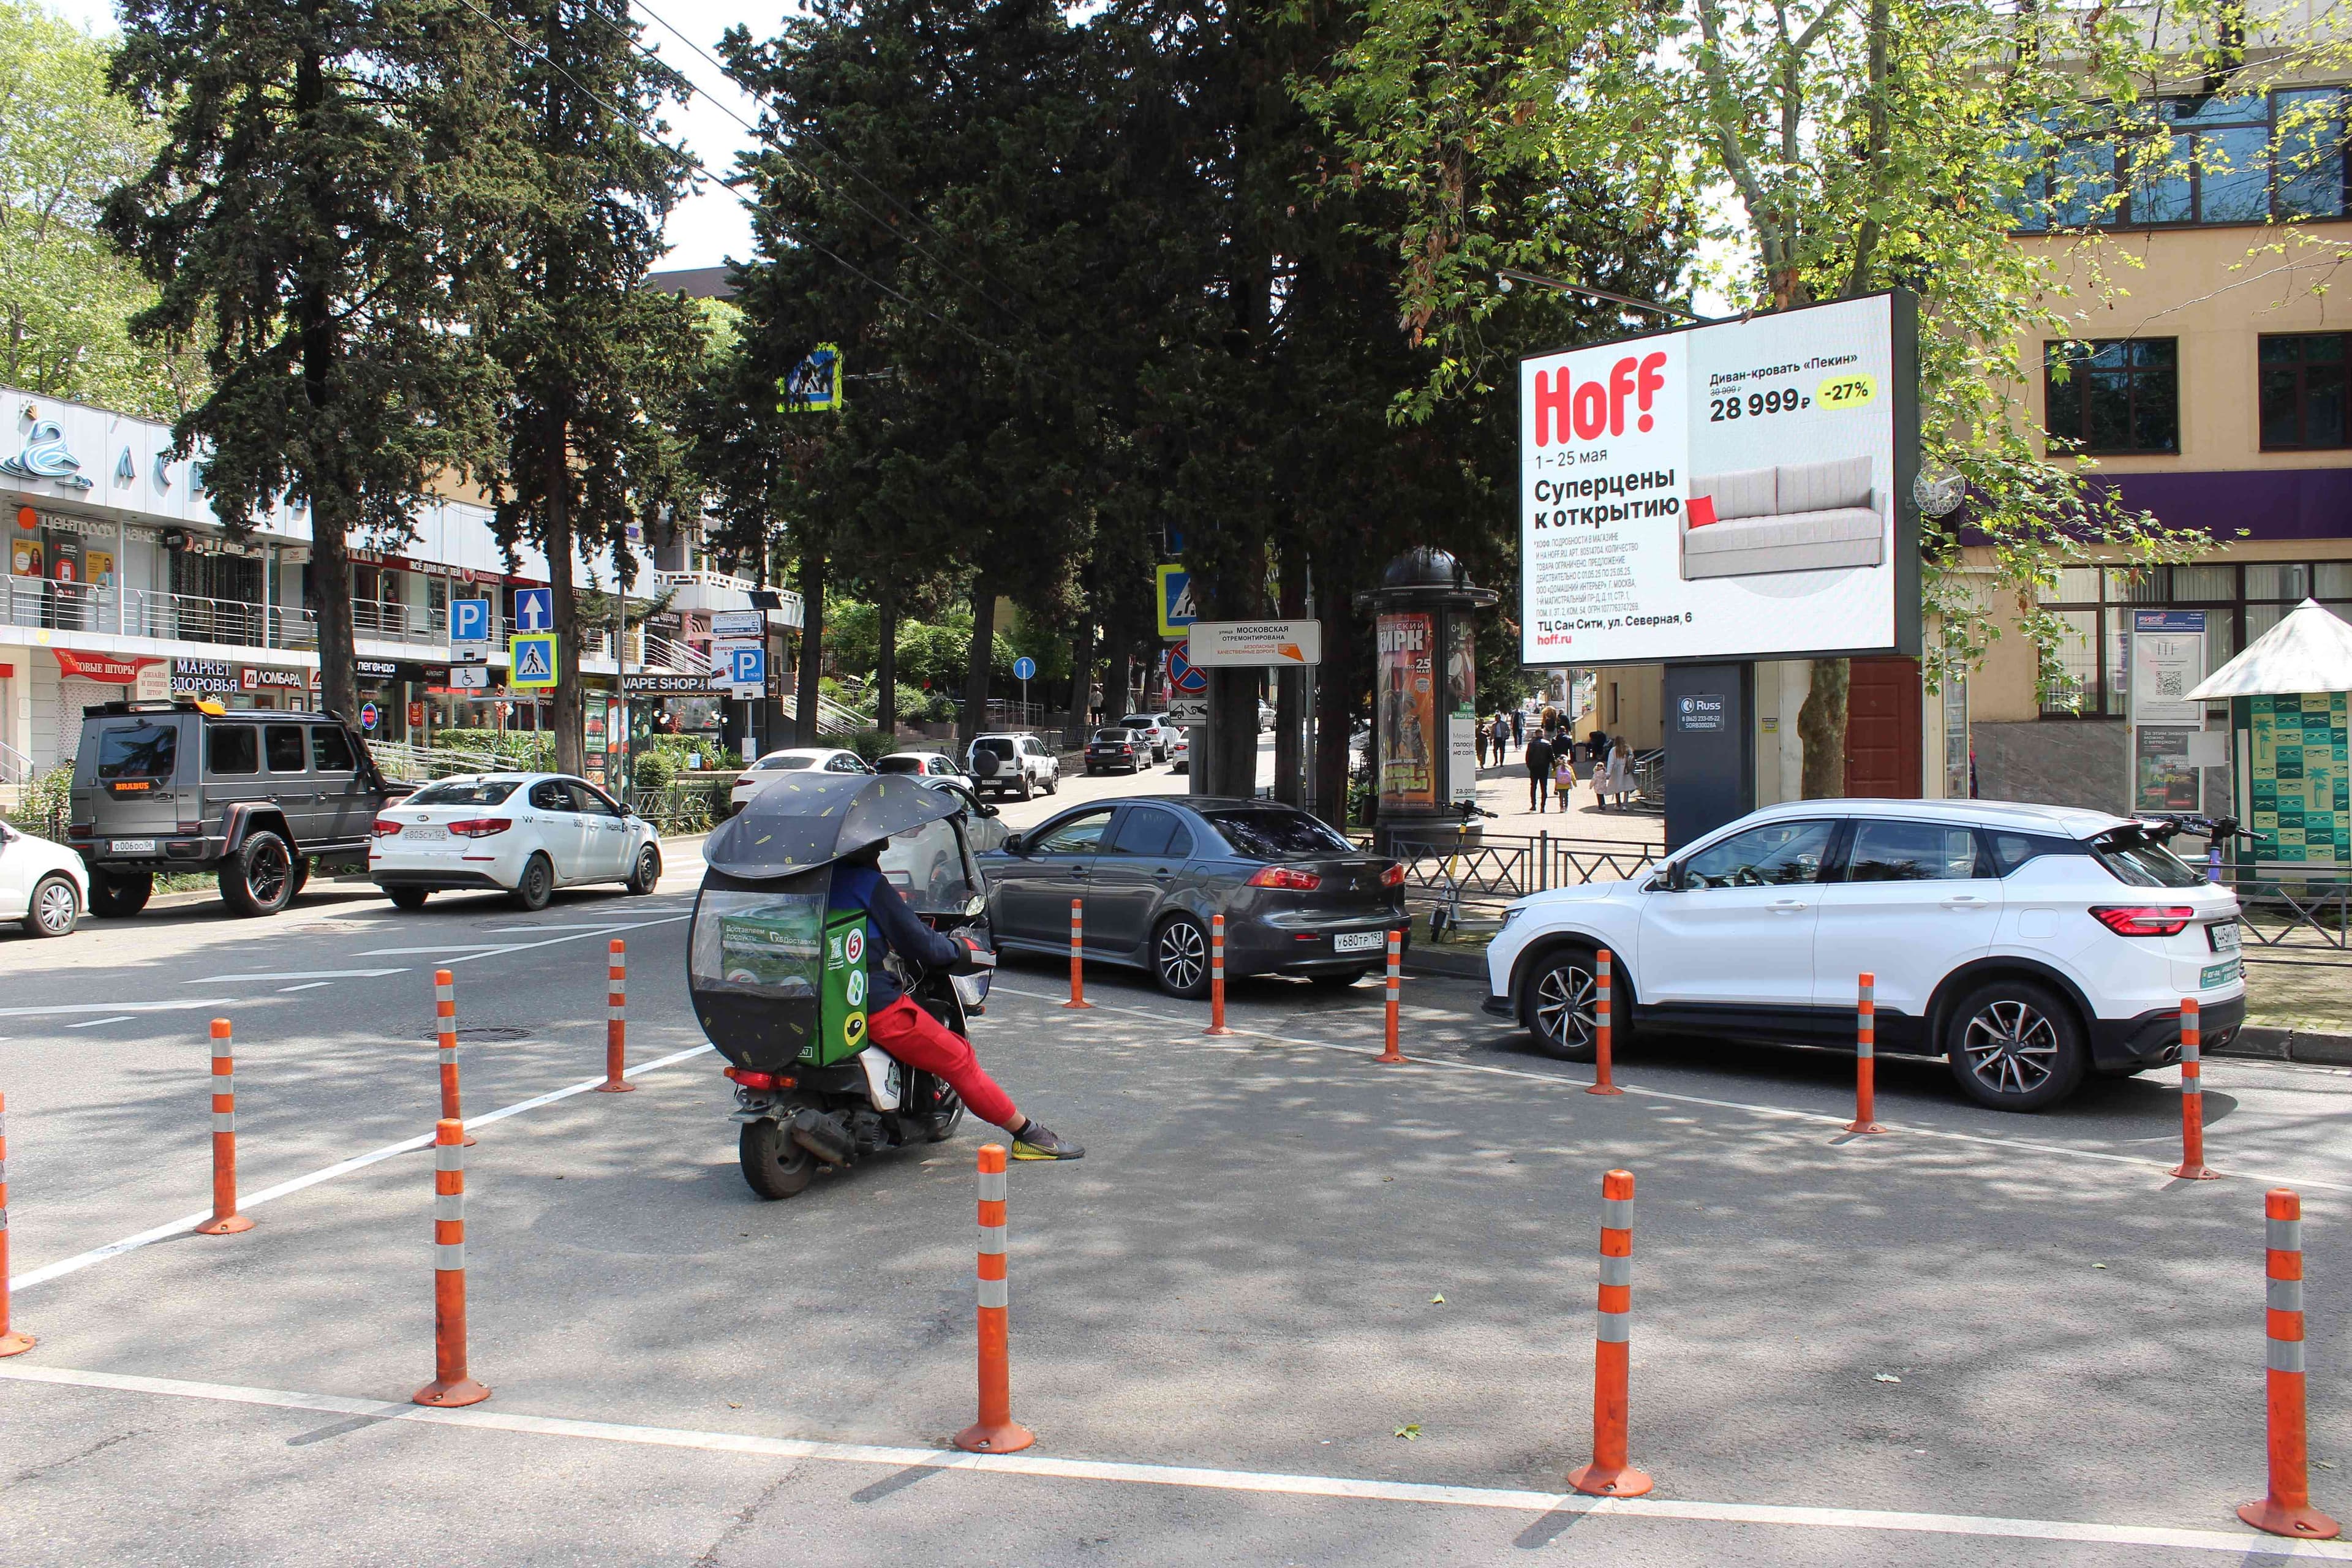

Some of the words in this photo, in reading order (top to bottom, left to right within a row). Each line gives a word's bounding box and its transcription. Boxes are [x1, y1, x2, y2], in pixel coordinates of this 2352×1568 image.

[1709, 363, 1800, 387] Диван-кровать
[1804, 353, 1858, 370] «Пекин»
[1824, 381, 1869, 401] -27%
[1535, 352, 1667, 447] Hoff
[1709, 397, 1741, 422] 28
[1536, 455, 1541, 469] 1
[1558, 451, 1575, 467] 25
[1580, 450, 1607, 464] мая
[1535, 469, 1675, 506] Суперцены
[1535, 512, 1548, 530] к
[1553, 497, 1679, 529] открытию
[1551, 535, 1588, 546] ПОДРОБНОСТИ
[1593, 532, 1619, 543] МАГАЗИНЕ
[1569, 548, 1580, 557] АРТ.
[1605, 543, 1638, 554] КОЛИЧЕСТВО
[1536, 562, 1554, 571] ТОВАРА
[1588, 556, 1626, 567] ПРЕДЛОЖЕНИЕ
[1536, 571, 1577, 584] ДЕЙСТВИТЕЛЬНО
[1545, 594, 1587, 605] МАГИСТРАЛЬНЫЙ
[1378, 621, 1424, 632] ОЧИНСКИЙ
[1537, 621, 1552, 633] ТЦ
[1555, 620, 1574, 631] Сан
[1577, 619, 1605, 630] Сити,
[1608, 617, 1623, 630] ул.
[1625, 614, 1683, 628] Северная,
[1685, 612, 1692, 623] 6
[1537, 635, 1572, 645] hoff.ru
[105, 663, 135, 675] ШТОРЫ
[1415, 658, 1431, 668] 25
[170, 676, 239, 692] ЗДОРОВЬЯ
[257, 670, 301, 688] ЛОМБАРД
[623, 677, 657, 690] VAPE
[660, 677, 698, 690] SHOP
[1696, 700, 1721, 710] Russ
[726, 925, 765, 935] Доставляем
[726, 933, 757, 942] продукты
